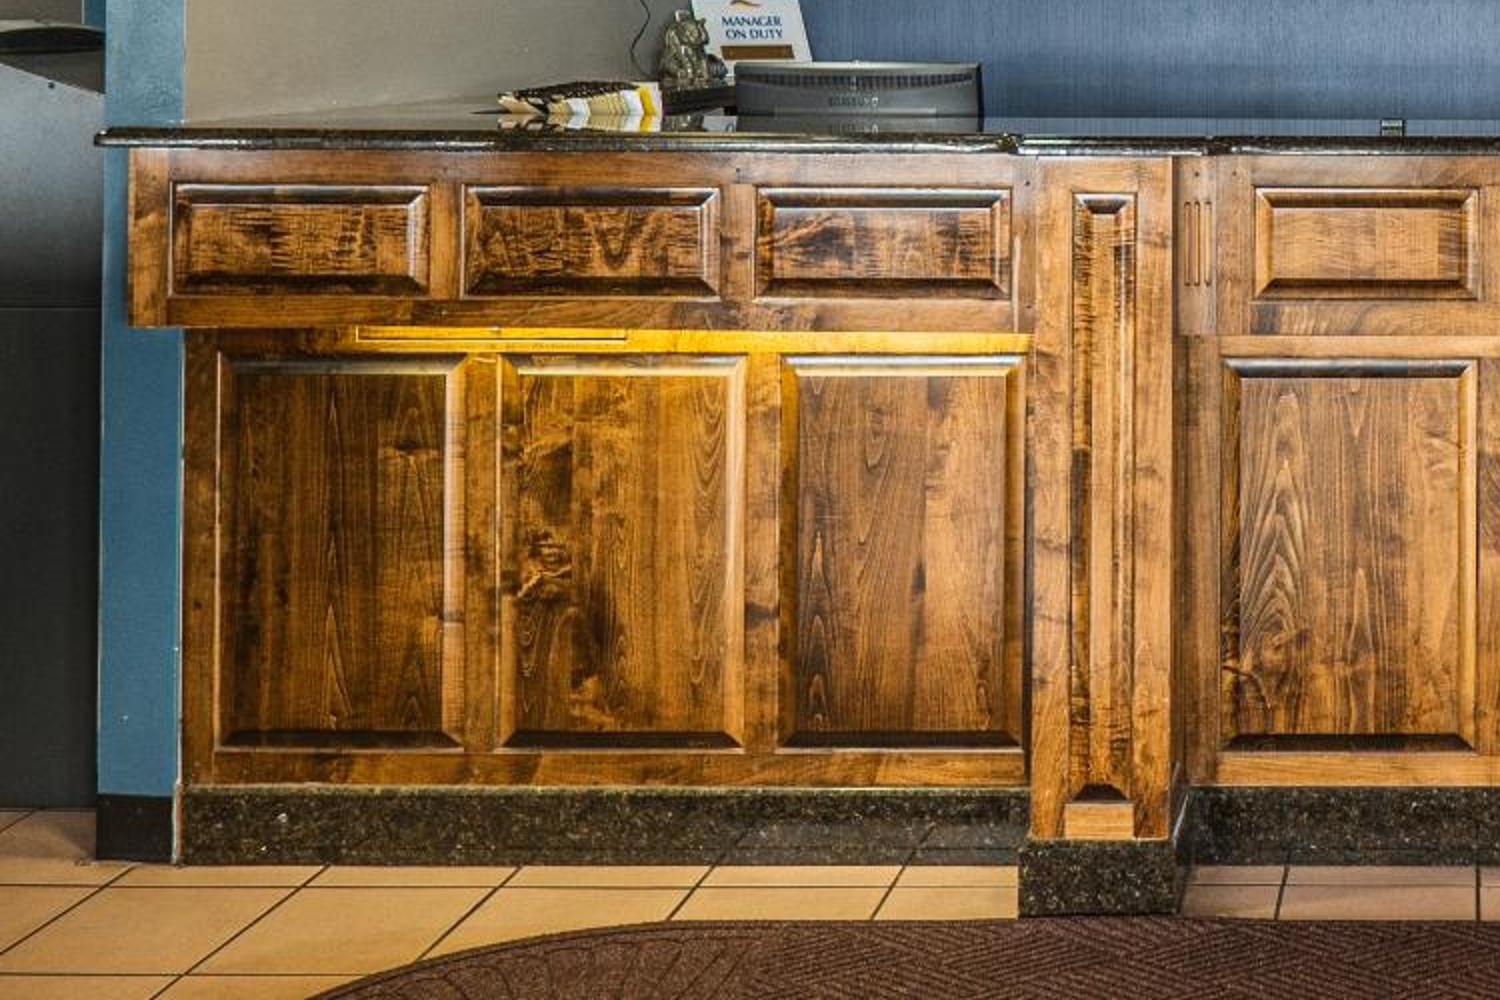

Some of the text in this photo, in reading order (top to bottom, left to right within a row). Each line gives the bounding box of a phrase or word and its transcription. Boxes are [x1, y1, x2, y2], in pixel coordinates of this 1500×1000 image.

[721, 15, 783, 27] MANAGER
[725, 29, 783, 40] ON DUTY
